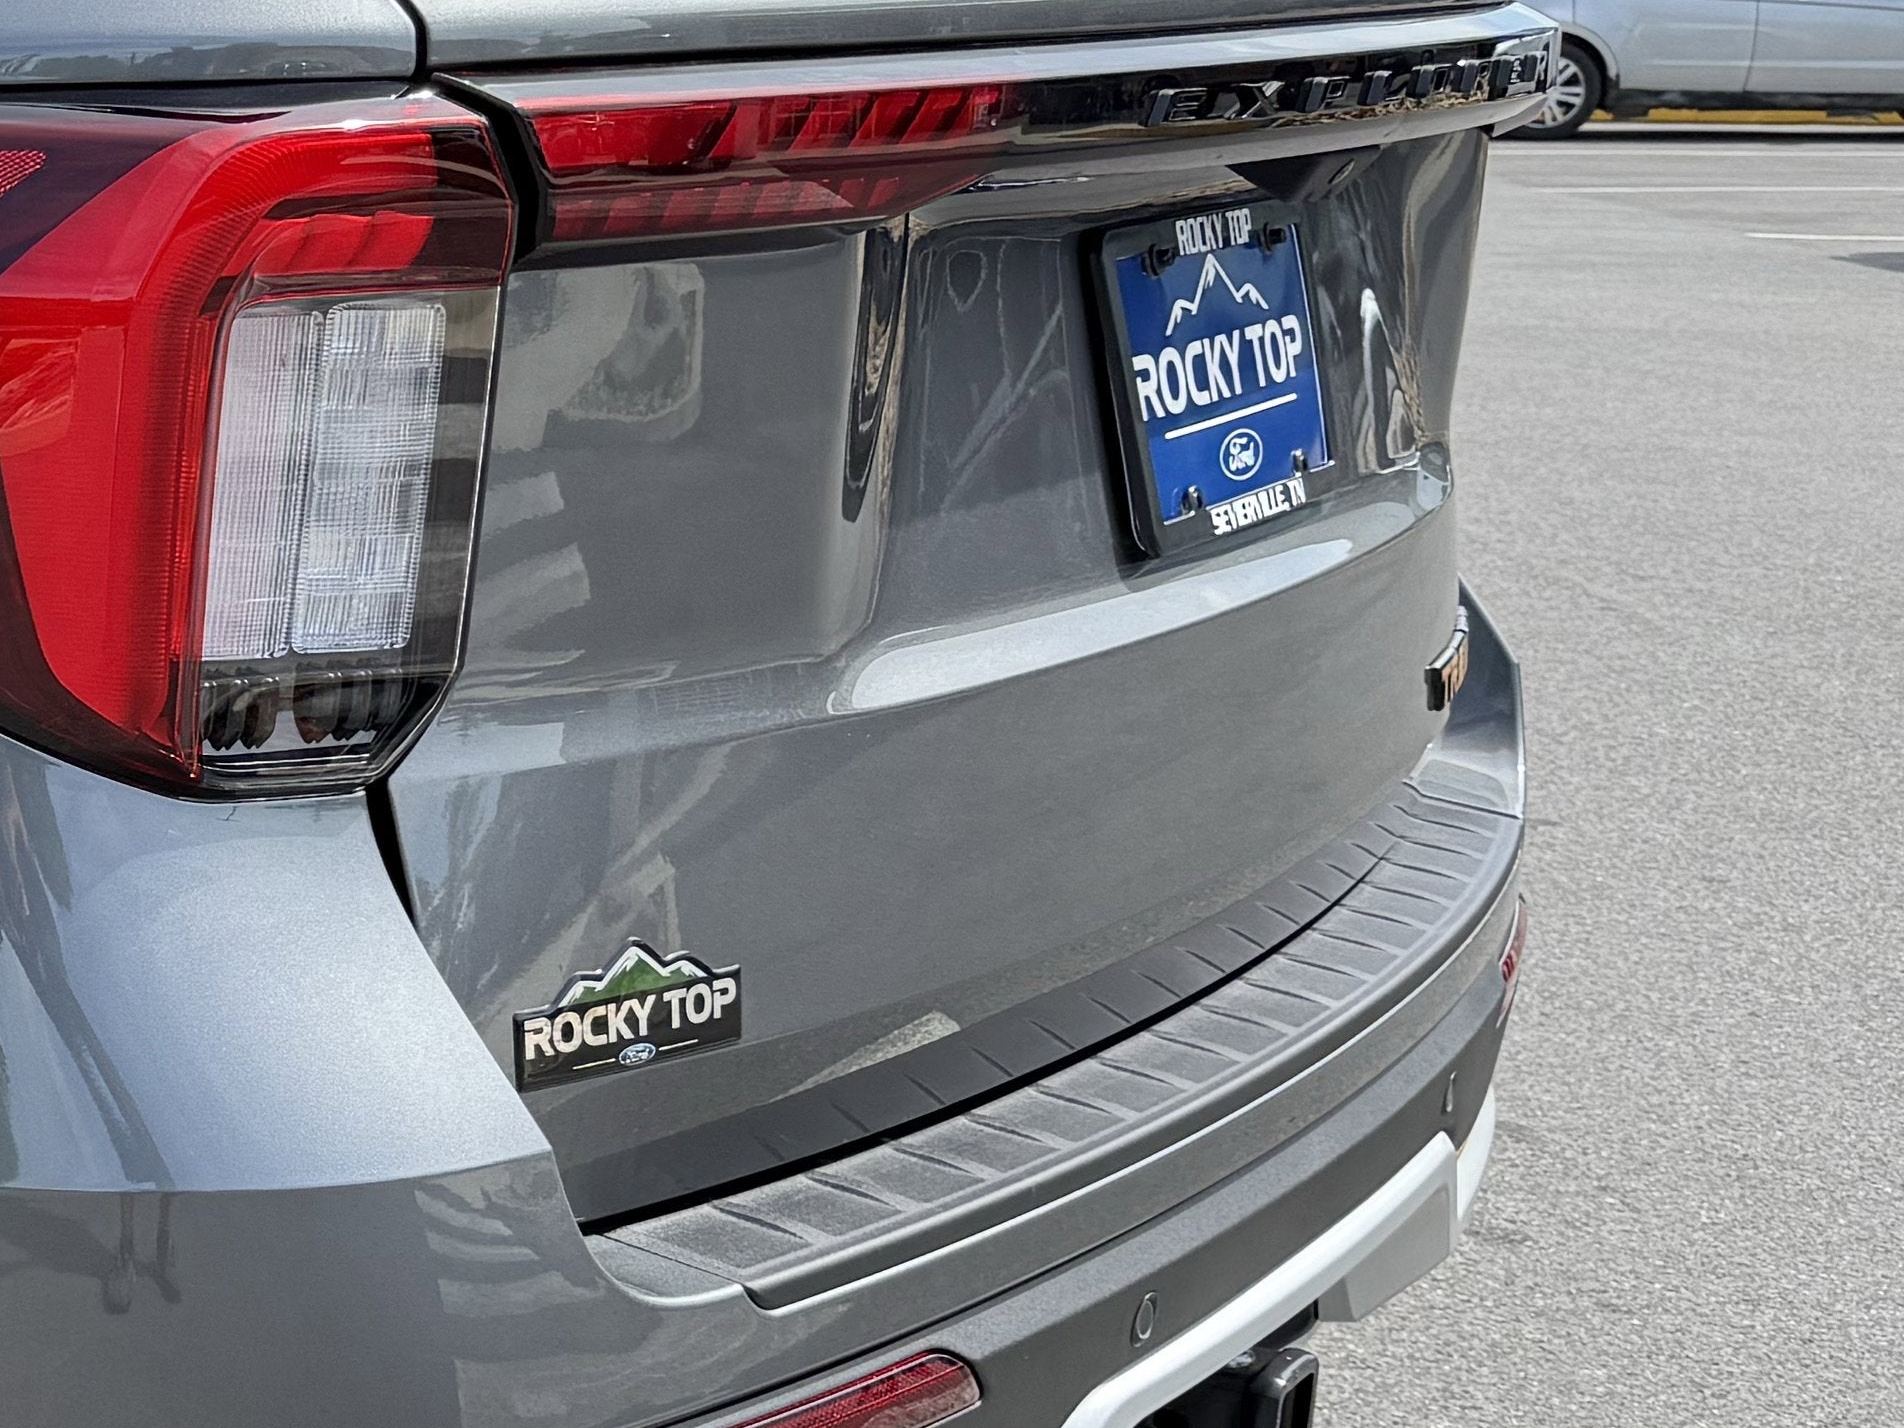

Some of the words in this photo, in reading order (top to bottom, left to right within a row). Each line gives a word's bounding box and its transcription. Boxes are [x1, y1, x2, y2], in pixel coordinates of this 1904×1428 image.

[1175, 212, 1224, 256] ROCKY
[1224, 207, 1252, 246] TOP
[1131, 328, 1243, 422] ROCKY
[1244, 314, 1303, 389] TOP
[523, 994, 657, 1061] ROCKY
[662, 976, 737, 1030] TOP
